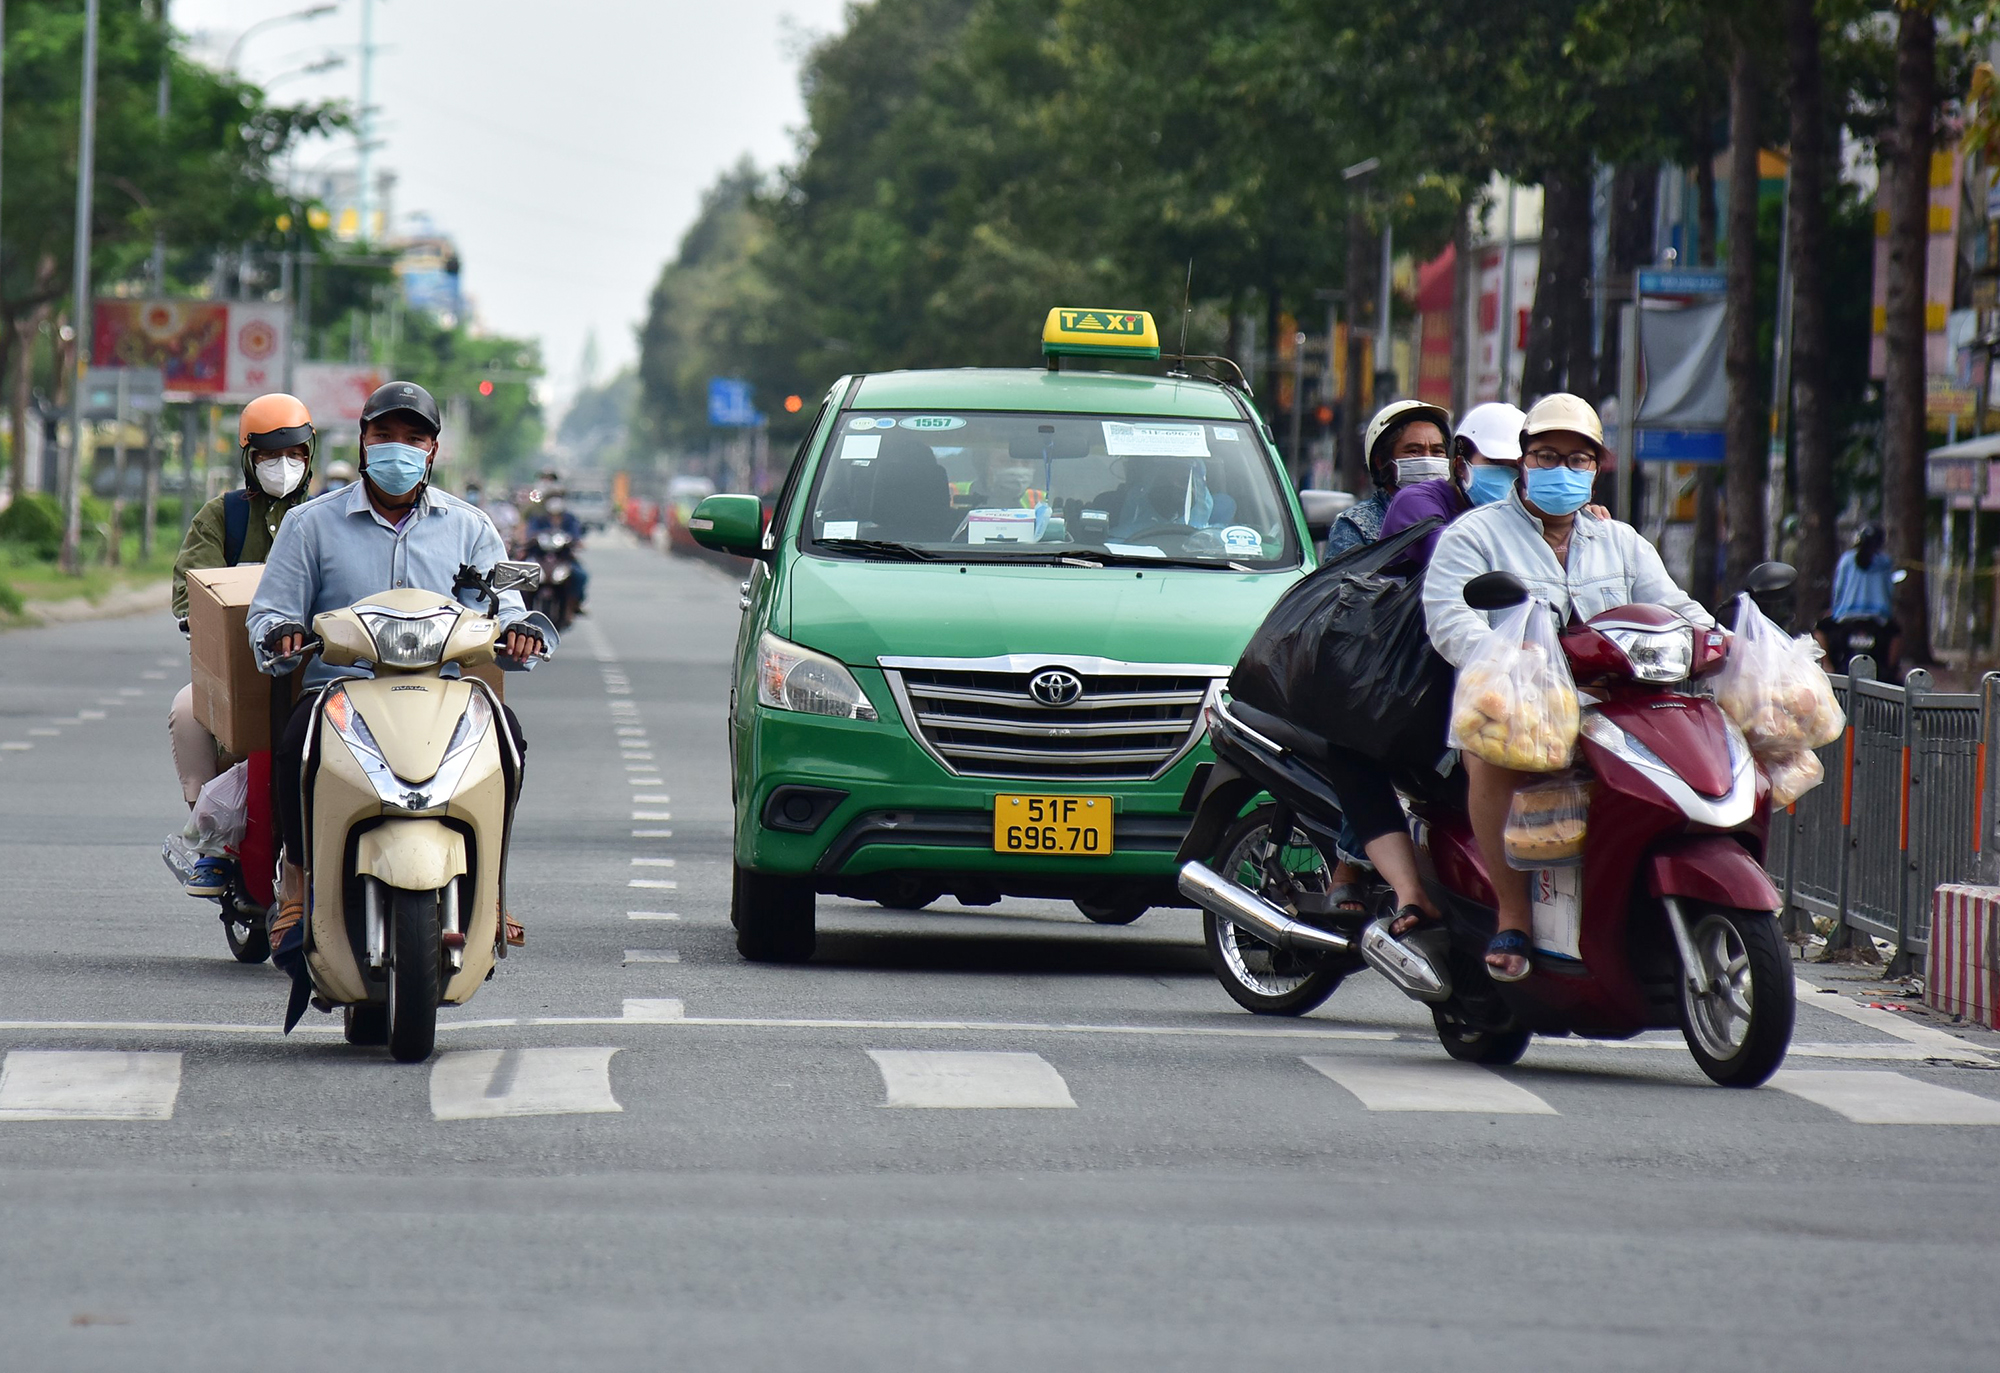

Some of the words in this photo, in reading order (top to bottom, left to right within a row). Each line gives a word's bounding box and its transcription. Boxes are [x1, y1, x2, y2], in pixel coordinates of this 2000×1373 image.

[914, 418, 952, 427] 1557
[1028, 799, 1078, 823] 51F
[1007, 826, 1098, 851] 696.70
